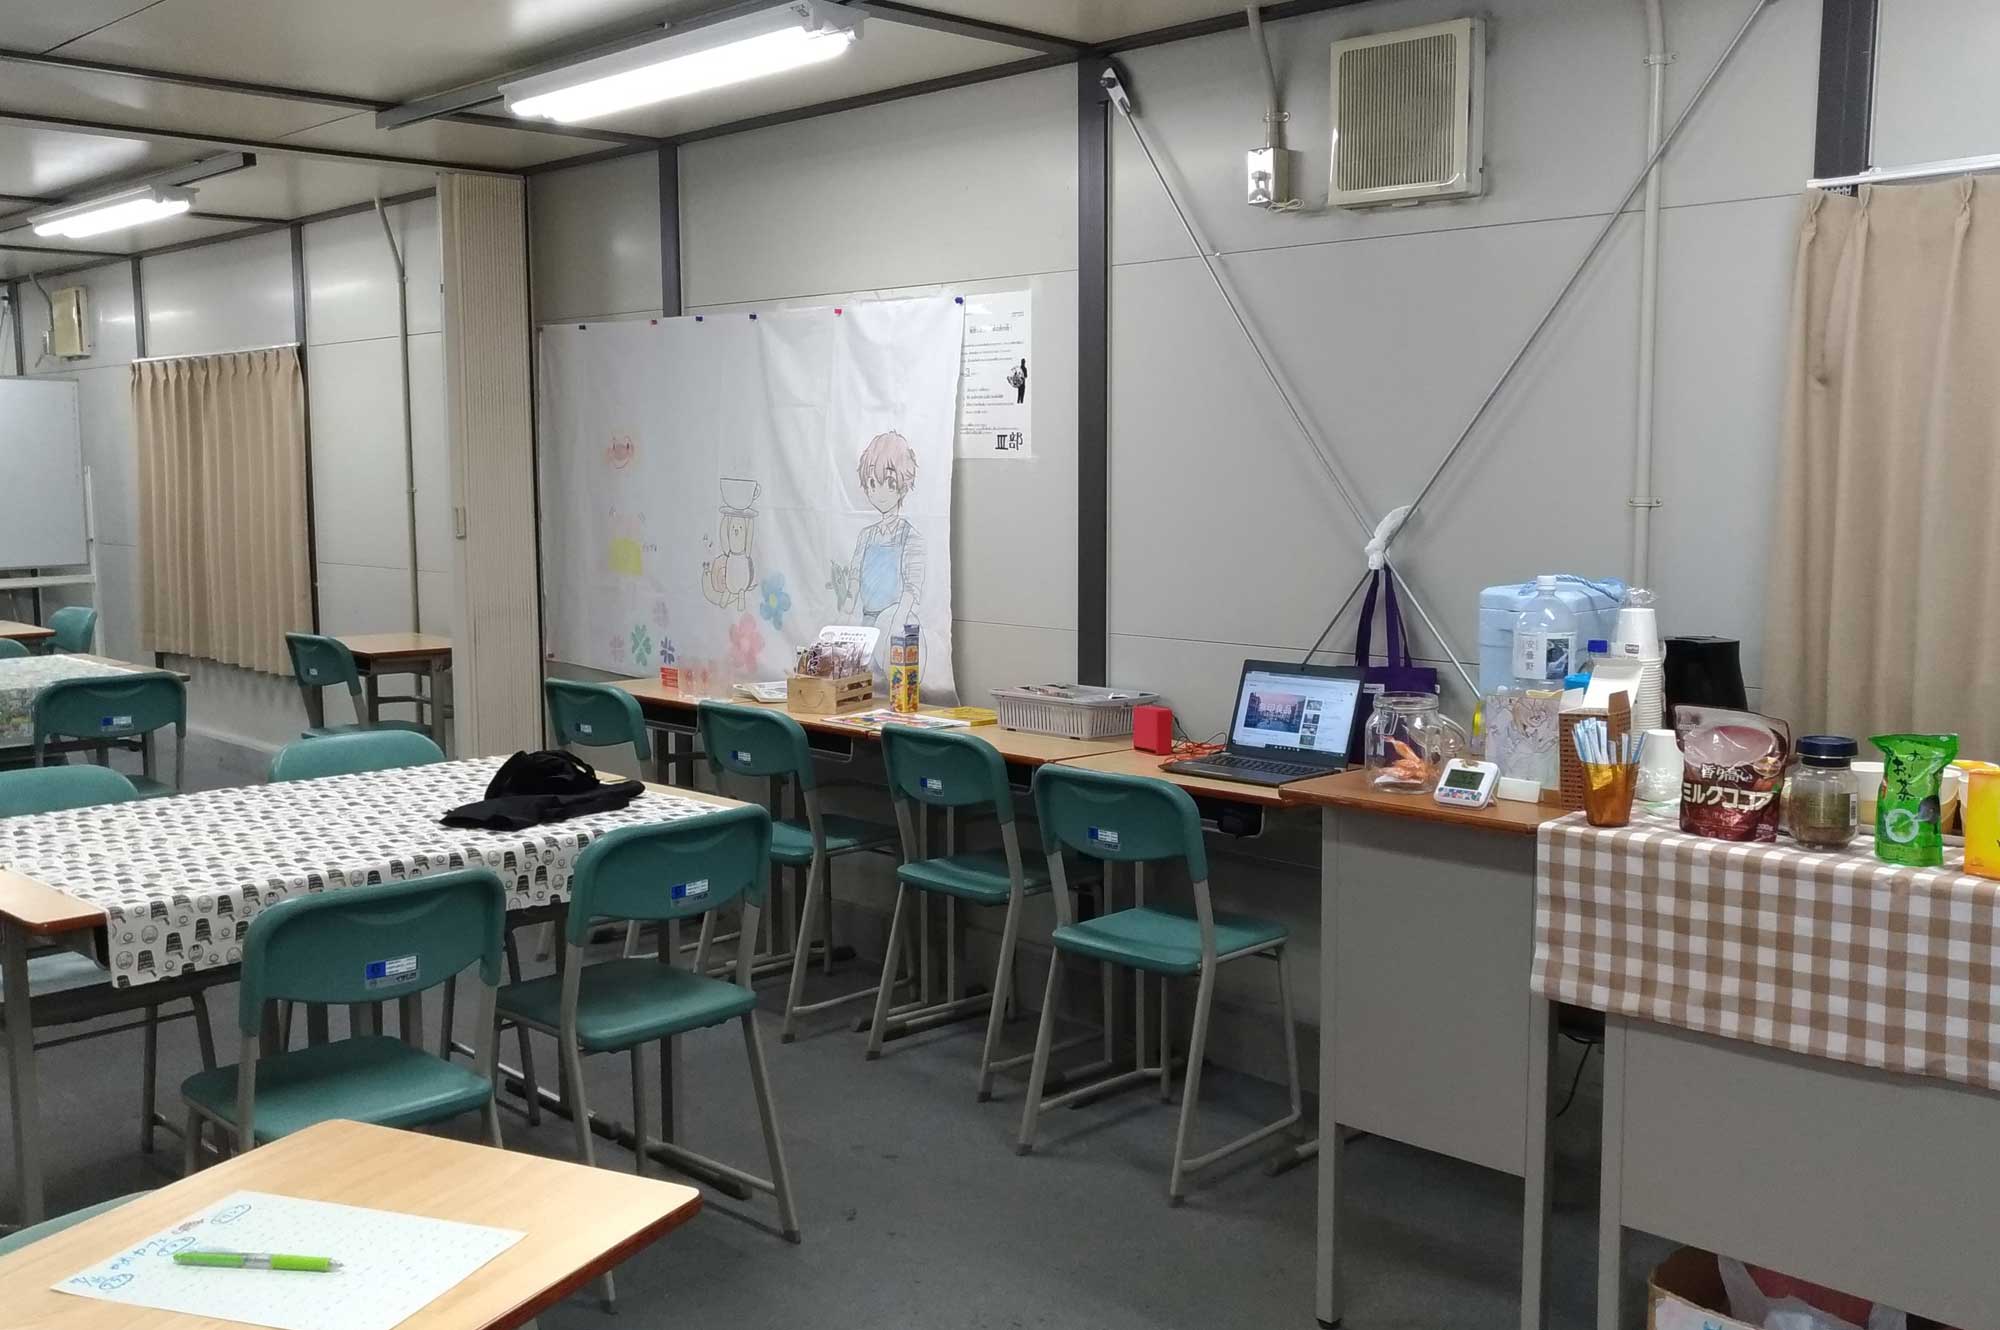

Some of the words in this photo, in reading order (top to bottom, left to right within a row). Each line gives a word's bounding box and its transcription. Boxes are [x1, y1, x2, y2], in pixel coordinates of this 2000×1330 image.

[1682, 782, 1774, 813] ミルクココア
[1892, 756, 1915, 802] お茶
